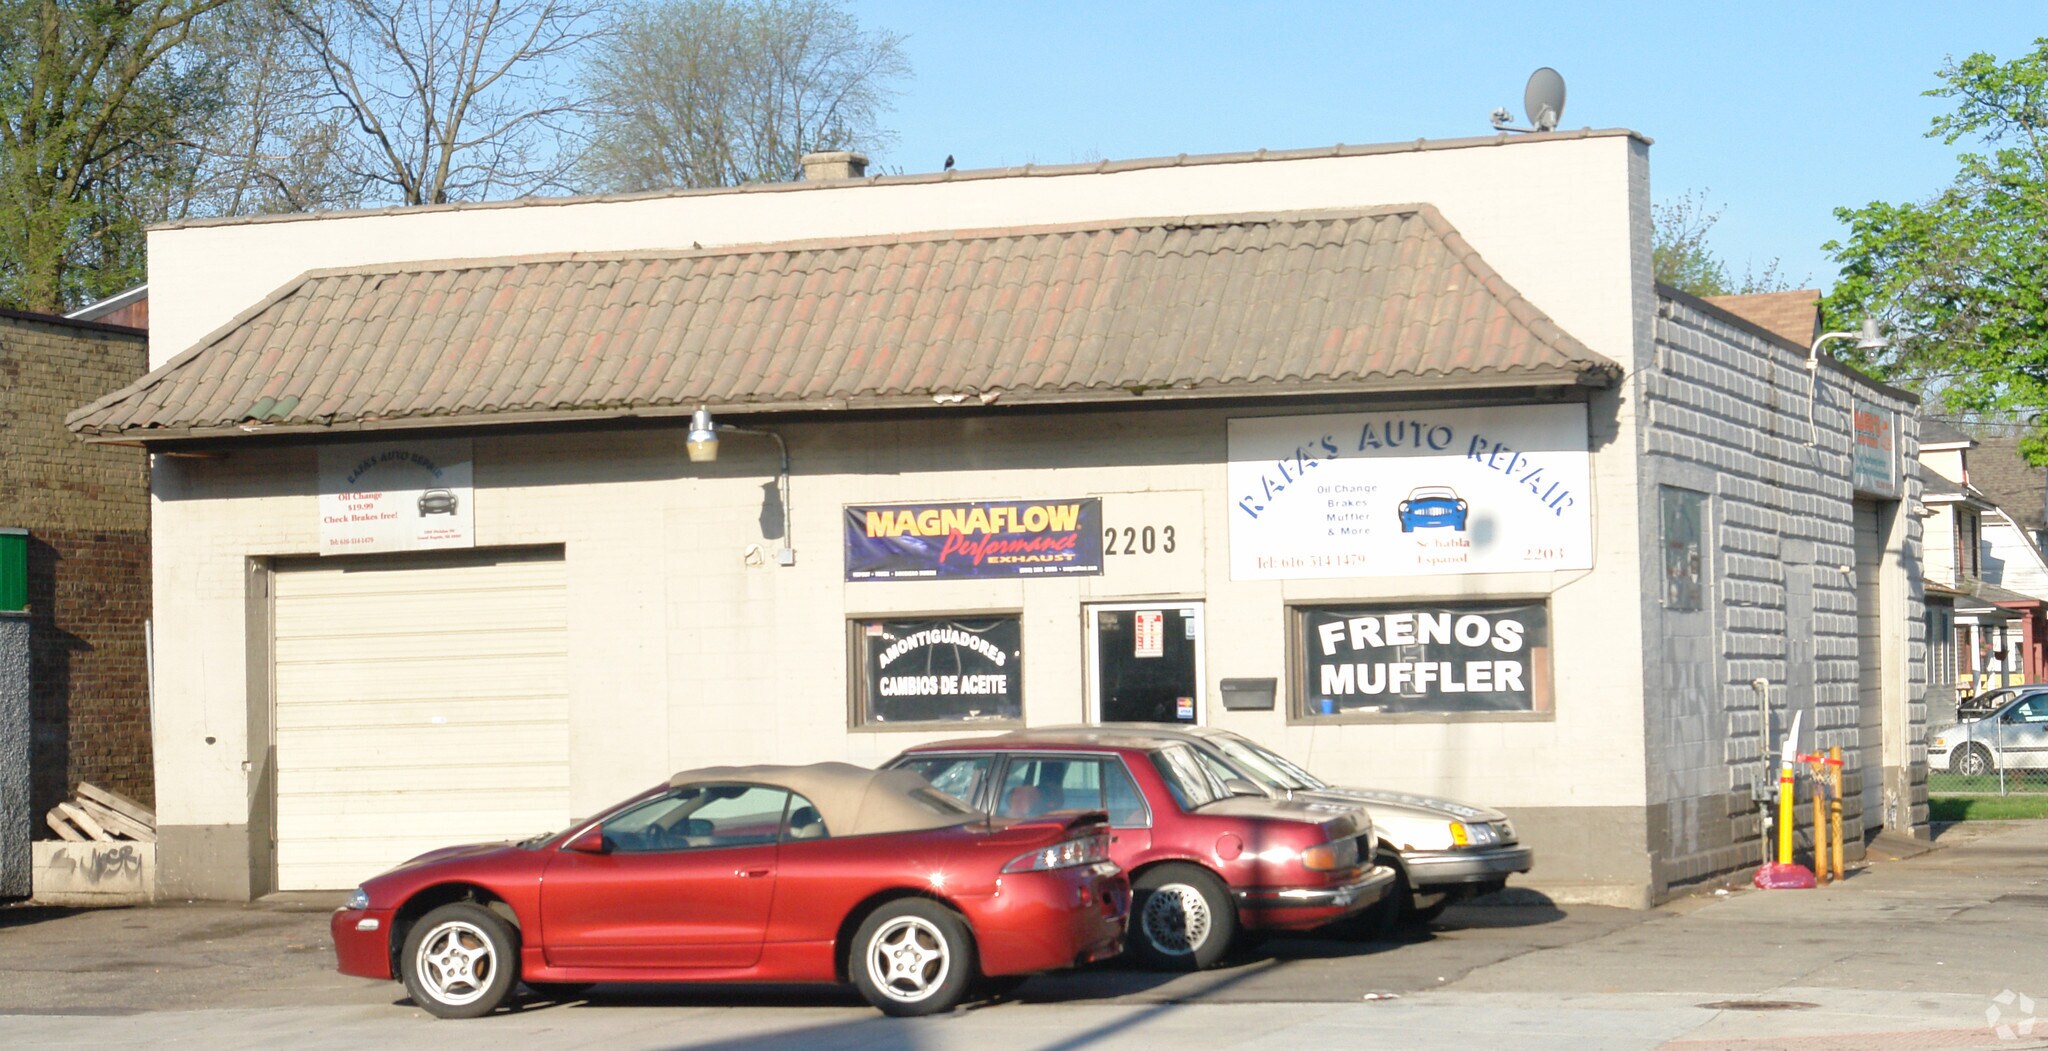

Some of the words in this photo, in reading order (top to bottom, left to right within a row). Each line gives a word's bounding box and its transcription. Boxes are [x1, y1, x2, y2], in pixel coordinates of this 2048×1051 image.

[380, 450, 409, 462] AUTO
[1239, 433, 1340, 519] RAFA'S
[1358, 420, 1454, 451] AUTO
[1467, 433, 1575, 517] REPAIR
[338, 493, 350, 501] Oil
[353, 491, 382, 501] Change
[1317, 485, 1331, 494] Oil
[1334, 485, 1377, 495] Change
[348, 502, 374, 511] $19.99
[1327, 499, 1368, 508] Brakes
[323, 515, 348, 524] Check
[351, 513, 378, 522] Brakes
[380, 512, 398, 520] free!
[866, 504, 1080, 538] MAGNAFLOW
[1326, 513, 1370, 521] Muffler
[1341, 527, 1370, 536] More
[939, 527, 1077, 566] Performance
[1104, 525, 1177, 556] 2203
[987, 553, 1077, 565] EXHAUST
[1524, 547, 1564, 561] 2203
[1318, 612, 1525, 656] FRENOS
[879, 628, 1006, 669] AMONTIGUADORES
[1320, 660, 1525, 695] MUFFLER
[879, 675, 938, 696] CAMBIOS
[940, 676, 959, 695] DE
[960, 674, 1007, 695] ACEITE
